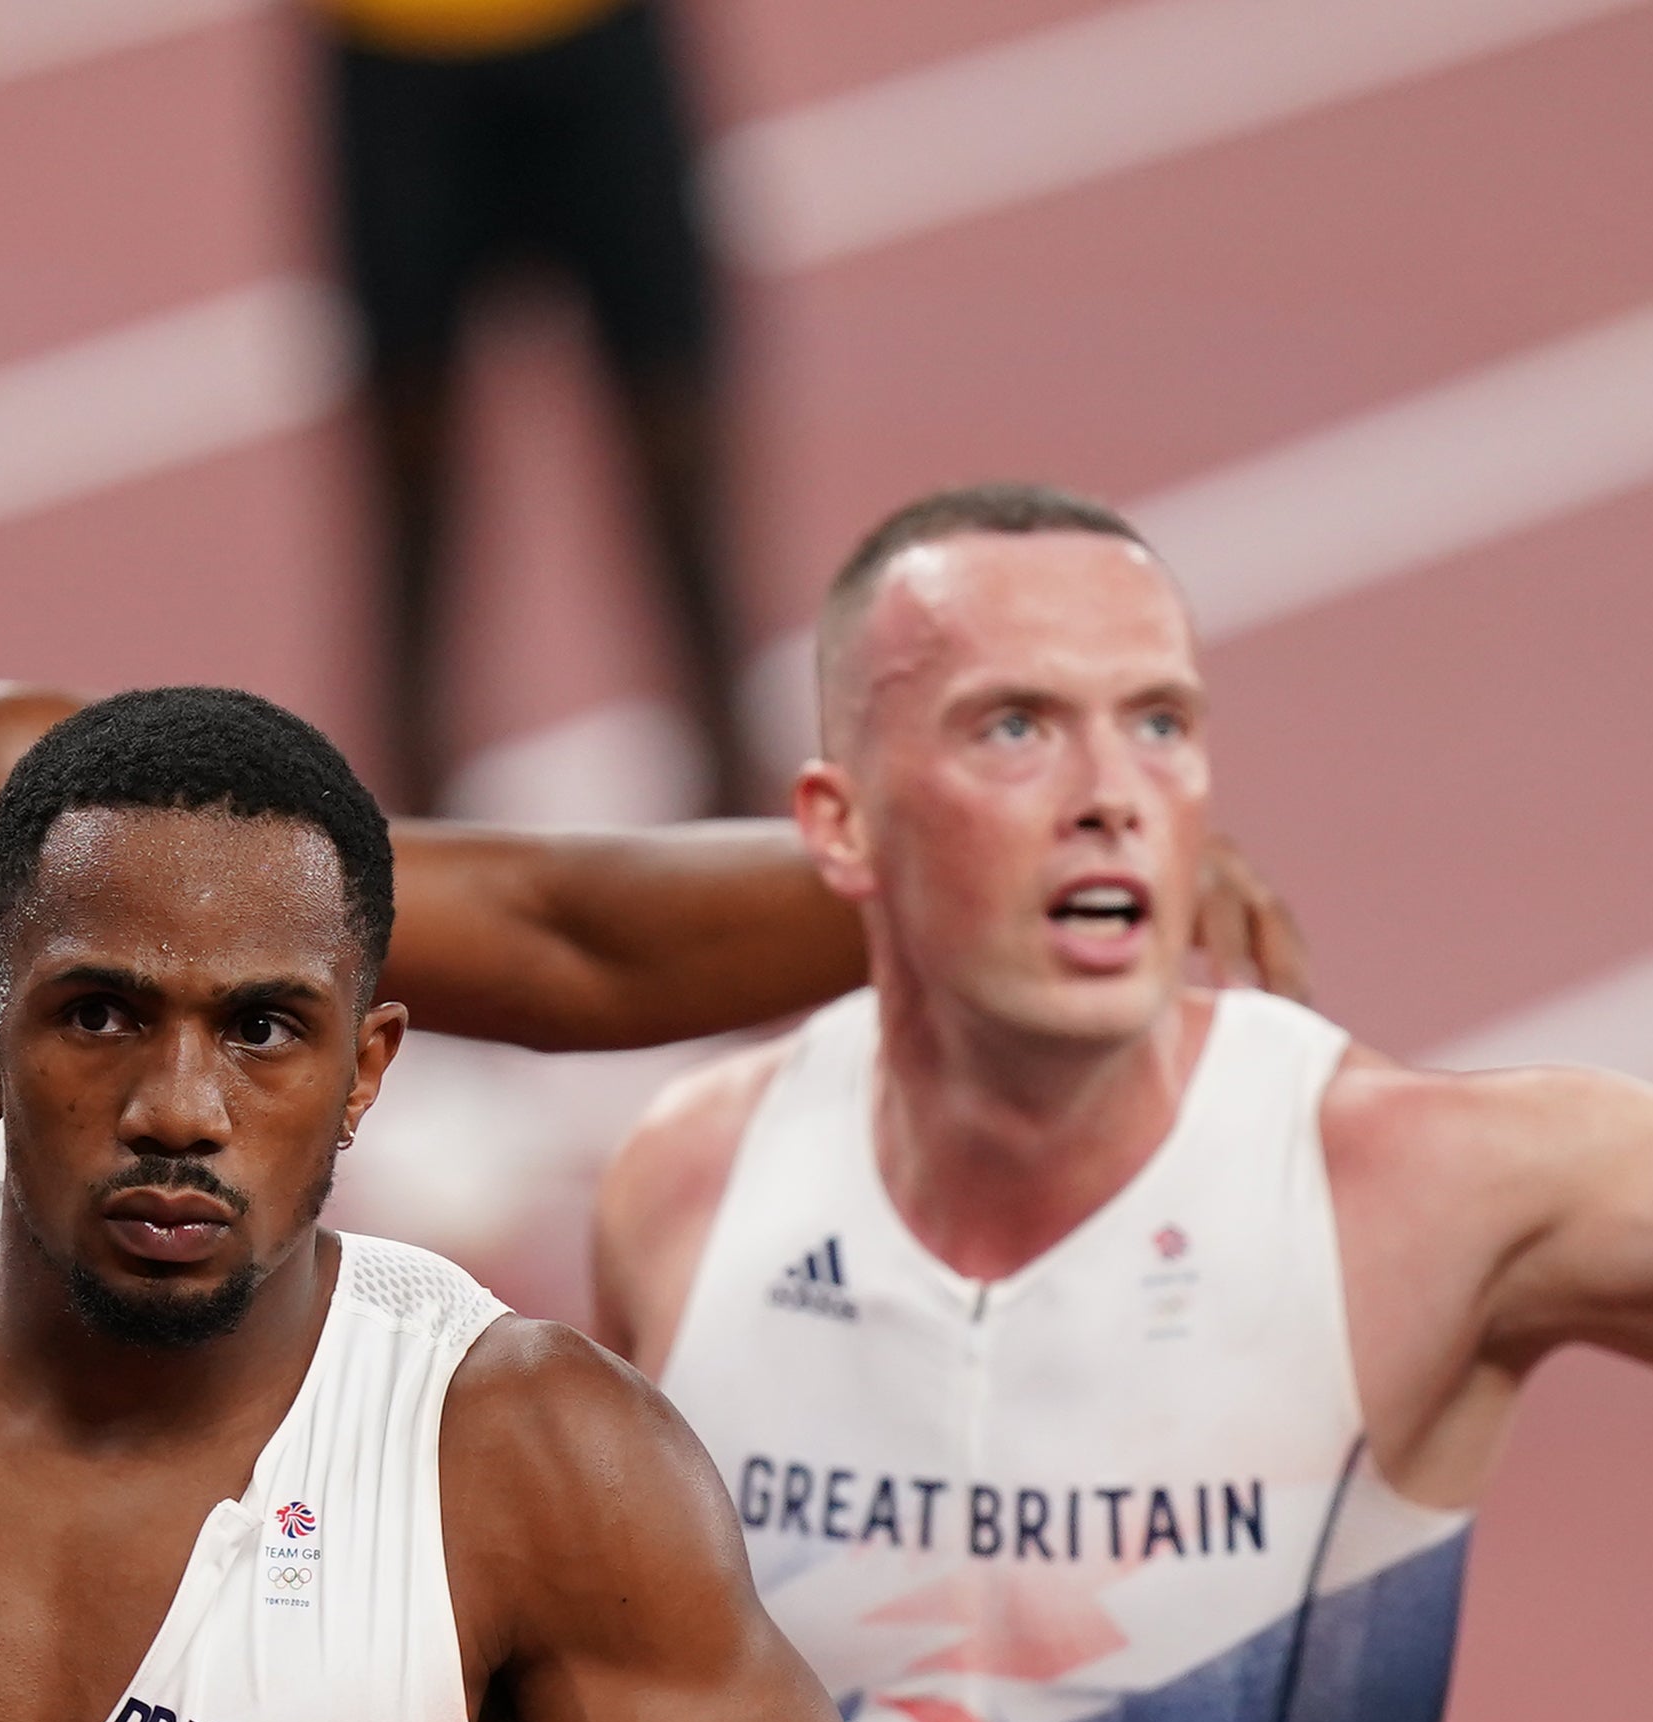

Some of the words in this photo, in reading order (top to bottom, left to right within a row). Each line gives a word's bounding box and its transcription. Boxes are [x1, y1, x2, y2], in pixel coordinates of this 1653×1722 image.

[739, 1454, 949, 1550] GREAT
[966, 1479, 1267, 1561] BRITAIN
[265, 1546, 298, 1559] TEAM
[302, 1548, 321, 1560] GB
